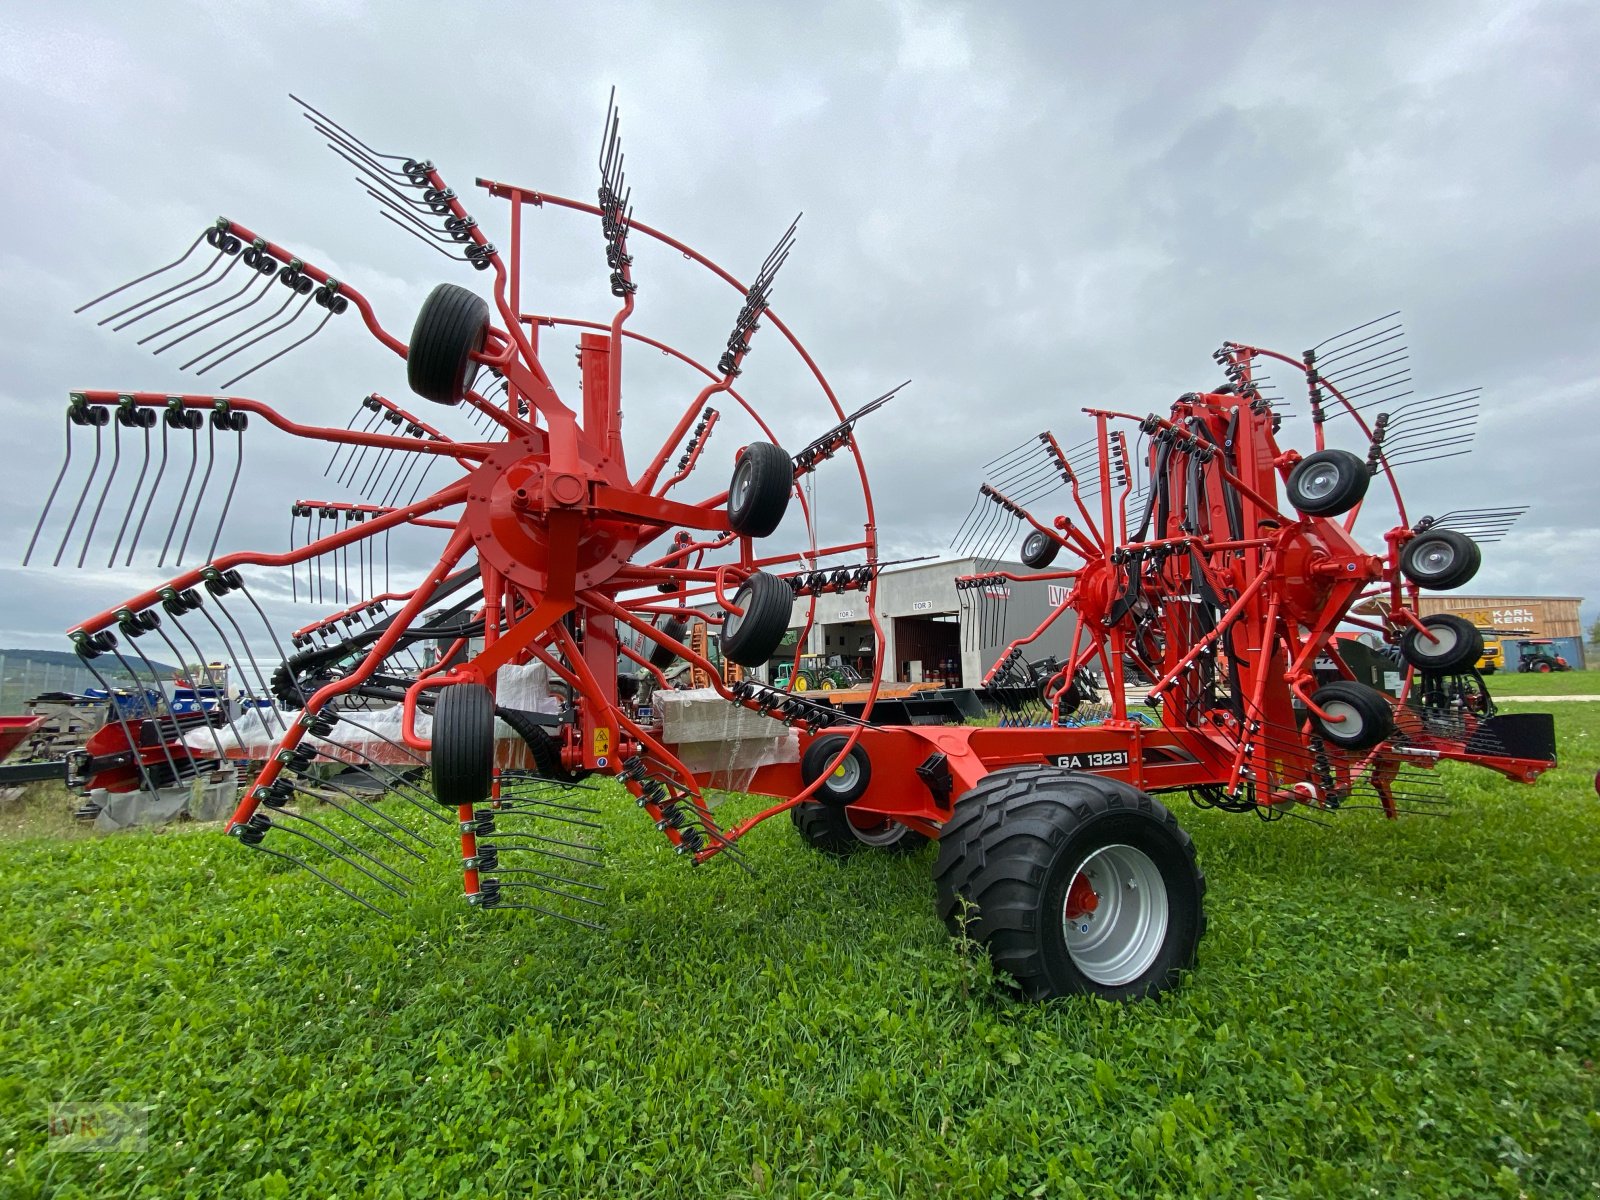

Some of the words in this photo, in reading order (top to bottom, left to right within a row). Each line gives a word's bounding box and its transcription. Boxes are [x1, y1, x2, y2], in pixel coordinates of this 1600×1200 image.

[1492, 609, 1533, 618] KARL
[1493, 616, 1534, 624] KERN
[1058, 756, 1081, 768] GA
[1088, 752, 1128, 766] 13231
